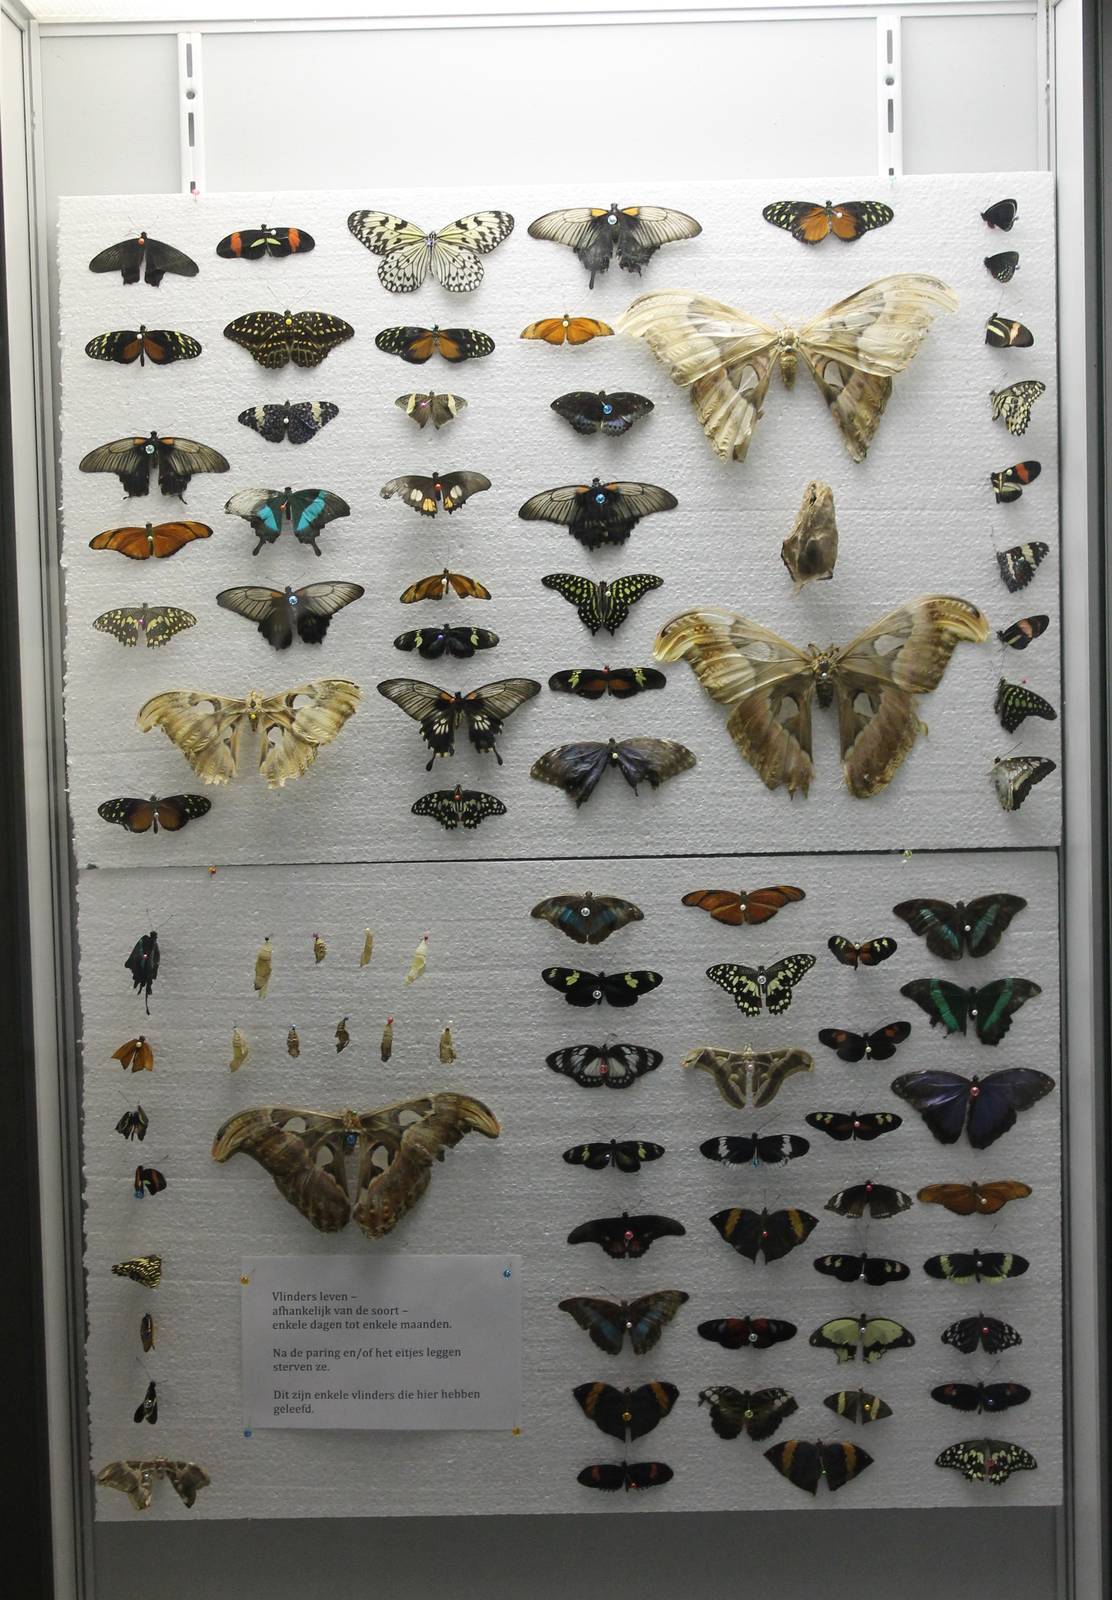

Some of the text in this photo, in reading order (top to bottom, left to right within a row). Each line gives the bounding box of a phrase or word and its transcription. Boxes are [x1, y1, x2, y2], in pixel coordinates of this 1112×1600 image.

[272, 1291, 317, 1302] Vlinders
[319, 1291, 348, 1302] leven
[272, 1305, 332, 1318] afhankelijk
[333, 1307, 353, 1316] van
[355, 1305, 369, 1316] de
[371, 1306, 400, 1316] soort
[272, 1318, 452, 1332] enkele dagen tot enkele maanden.
[272, 1347, 462, 1361] Na de paring en/of het eitjes leggen
[273, 1362, 330, 1373] sterven ze.
[273, 1388, 481, 1402] Dit zijn enkele vlinders die hier hebben
[273, 1403, 314, 1417] geleefd.
